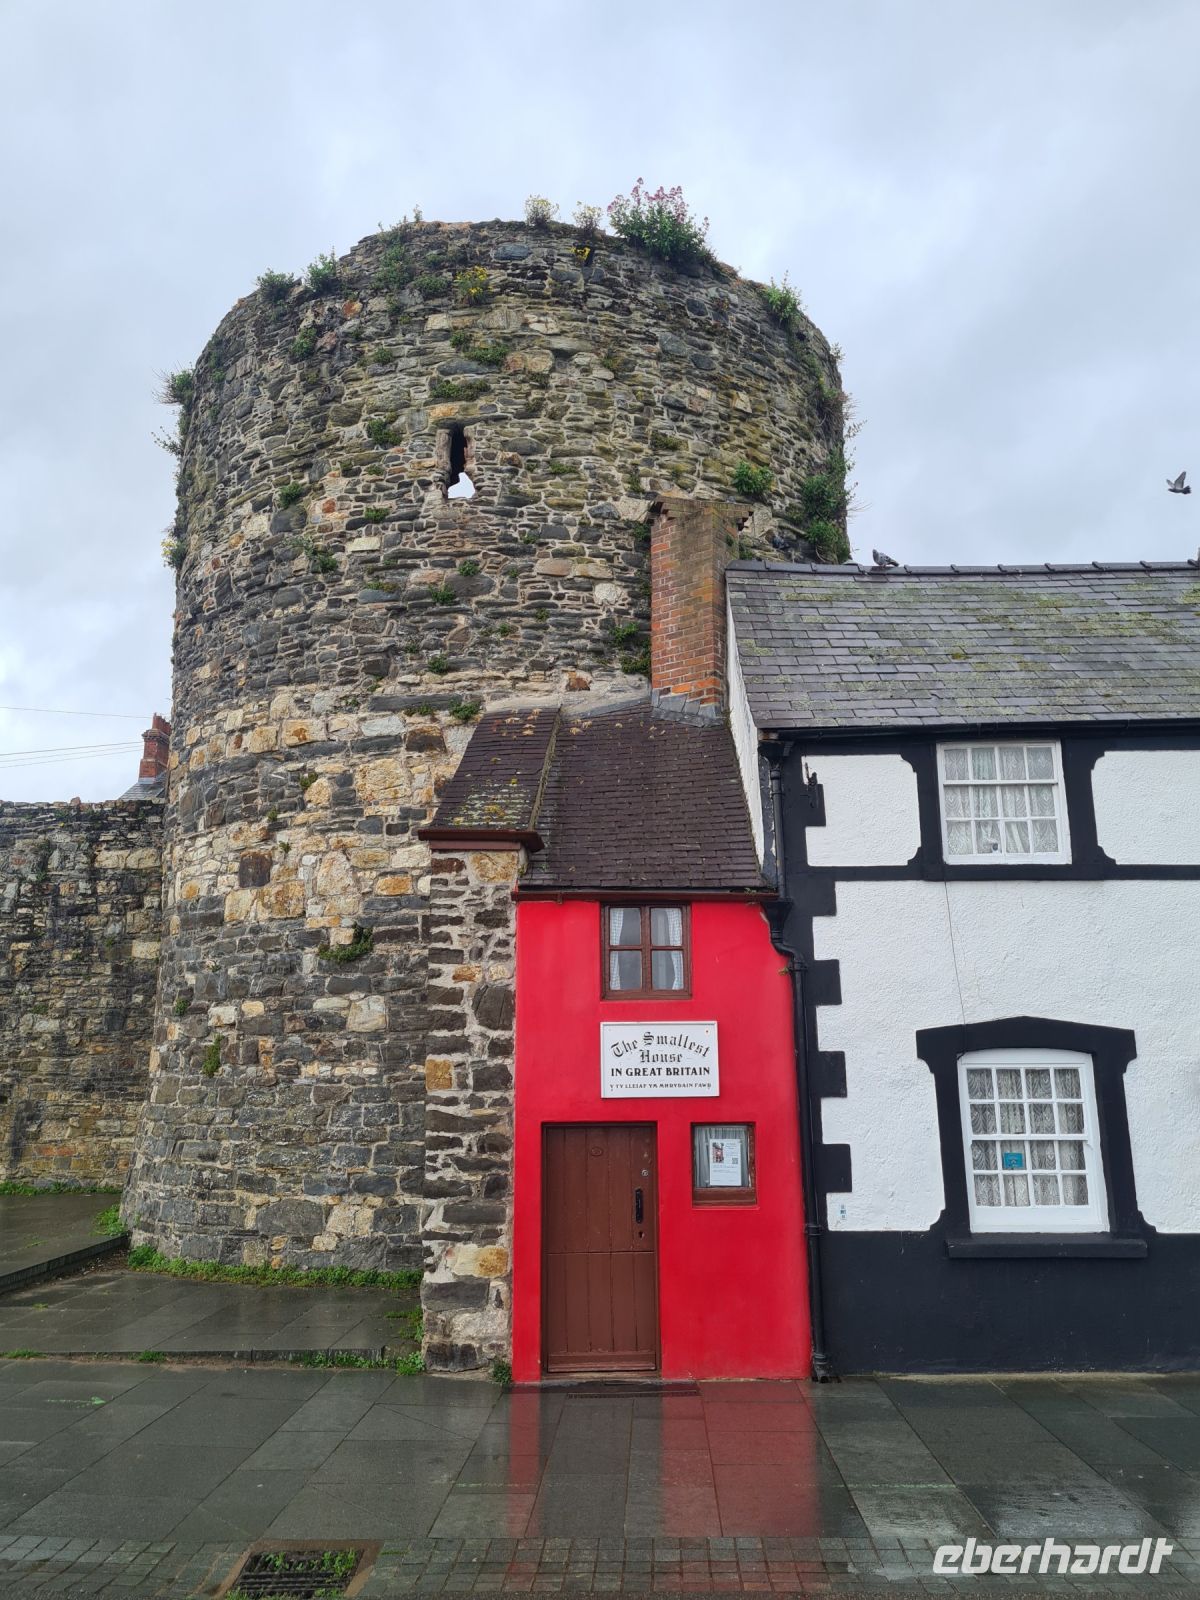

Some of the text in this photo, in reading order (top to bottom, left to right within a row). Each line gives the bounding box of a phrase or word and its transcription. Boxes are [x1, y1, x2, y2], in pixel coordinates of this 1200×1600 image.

[610, 1031, 710, 1058] The Smallest
[639, 1049, 683, 1063] House
[611, 1066, 710, 1076] IN GREAT BRITAIN
